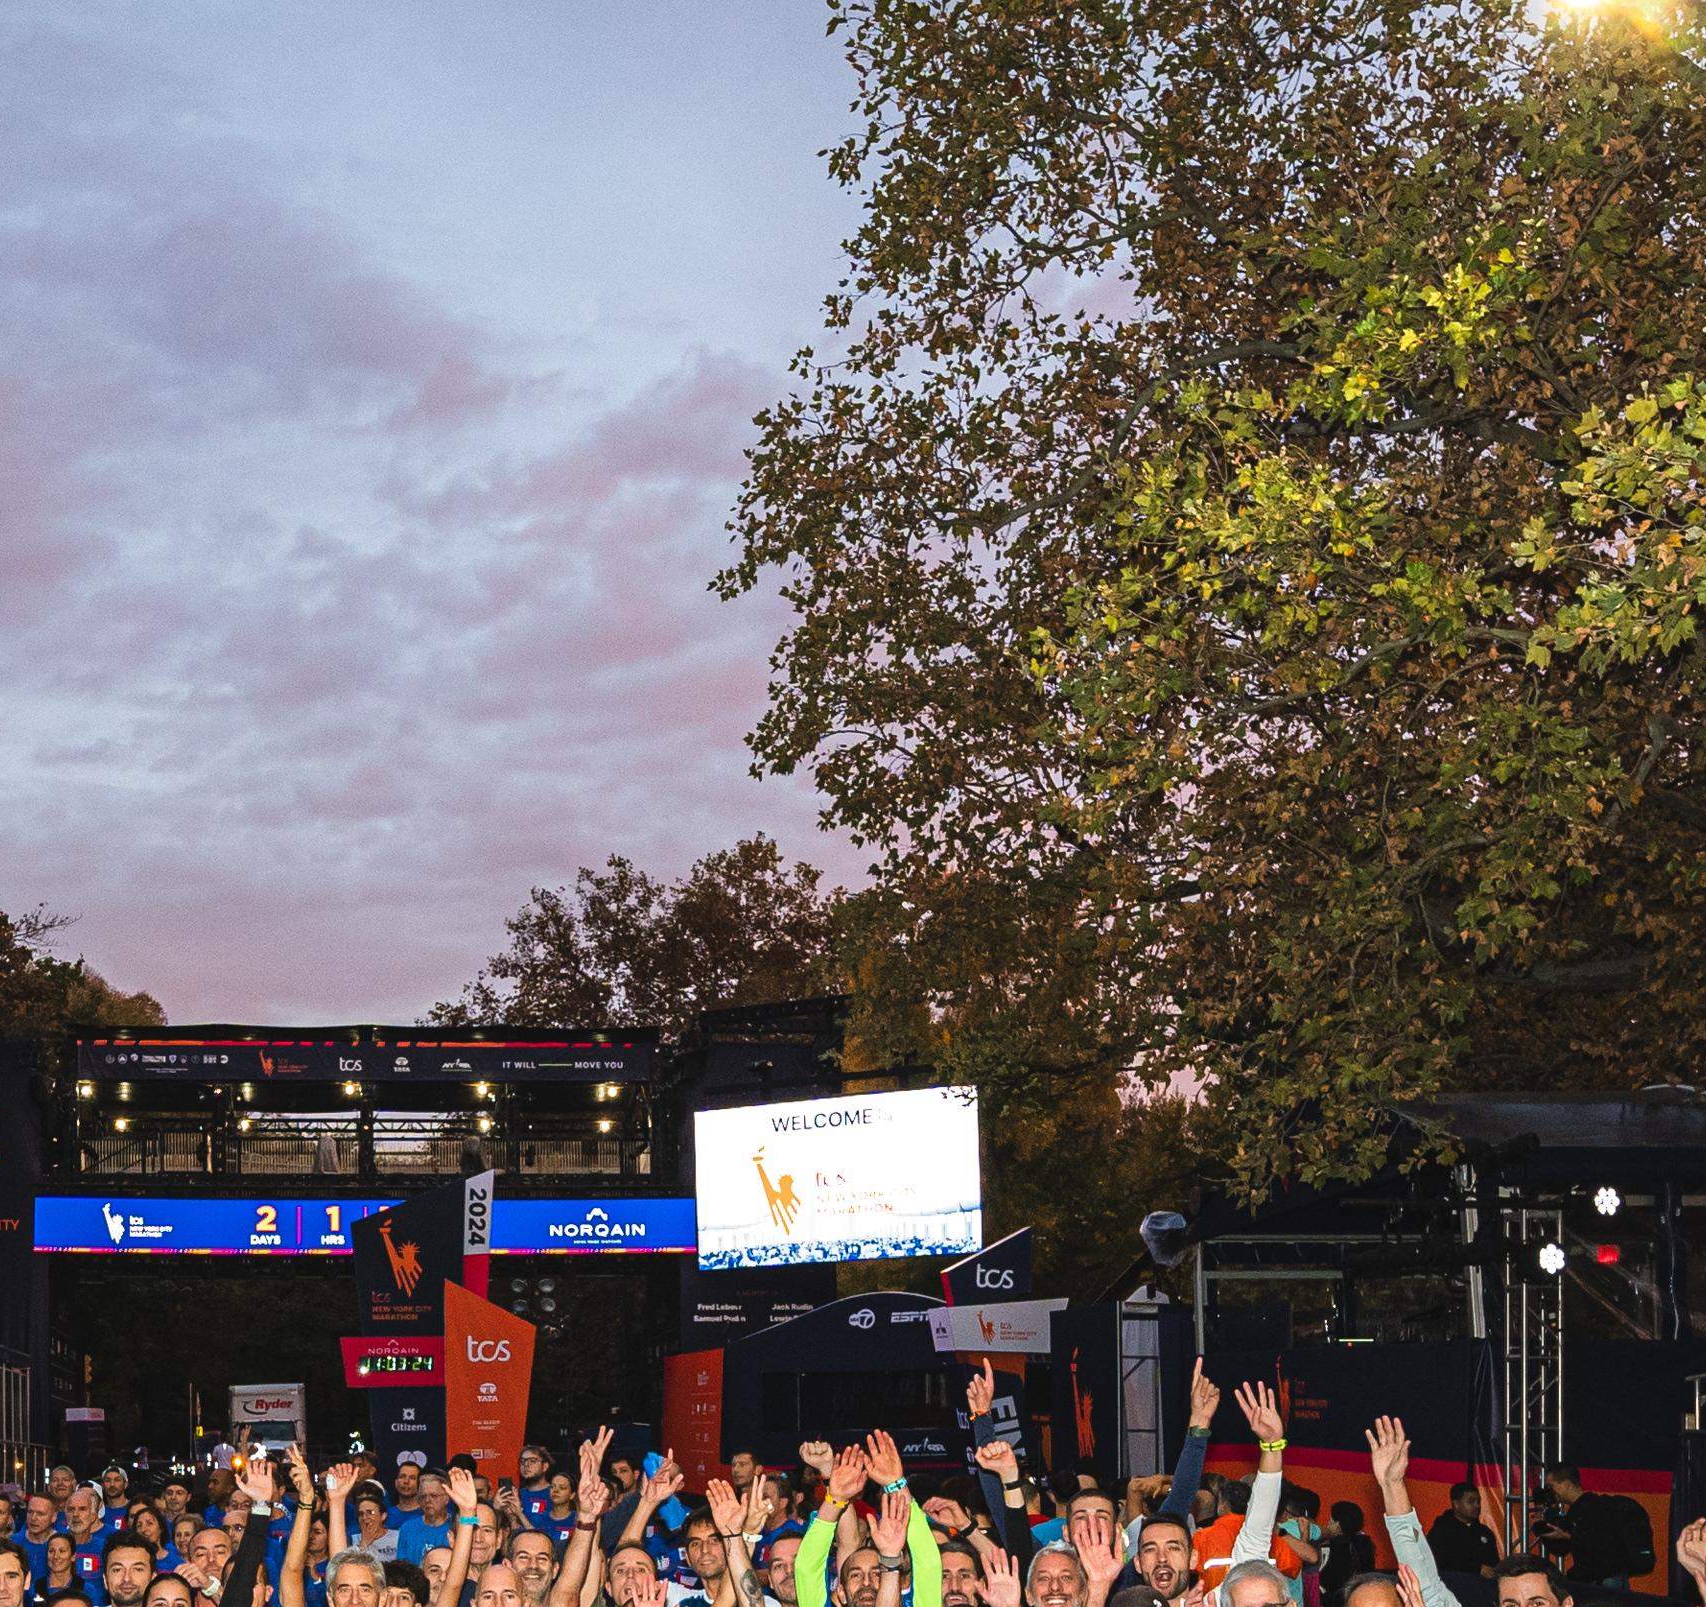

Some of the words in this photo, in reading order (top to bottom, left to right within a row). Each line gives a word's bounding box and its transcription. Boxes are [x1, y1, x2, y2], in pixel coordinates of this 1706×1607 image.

[339, 1056, 363, 1072] tcs
[502, 1061, 512, 1069] IT
[515, 1061, 536, 1069] WILL
[574, 1061, 601, 1069] MOVE
[603, 1061, 624, 1069] YOU
[771, 1108, 873, 1133] WELCOME
[256, 1205, 277, 1232] 2
[325, 1205, 341, 1232] 1
[468, 1188, 488, 1246] 2024
[549, 1223, 646, 1237] NORQAIN
[250, 1235, 281, 1246] DAYS
[320, 1235, 346, 1246] HRS
[976, 1263, 1015, 1289] tcs
[372, 1305, 390, 1313] NEW
[414, 1305, 433, 1313] CITY
[697, 1303, 715, 1311] Fred
[771, 1303, 790, 1311] Jack
[693, 1315, 723, 1323] Samuel
[466, 1335, 512, 1363] tcs
[254, 1398, 294, 1411] Ryder
[391, 1422, 428, 1432] Citizens
